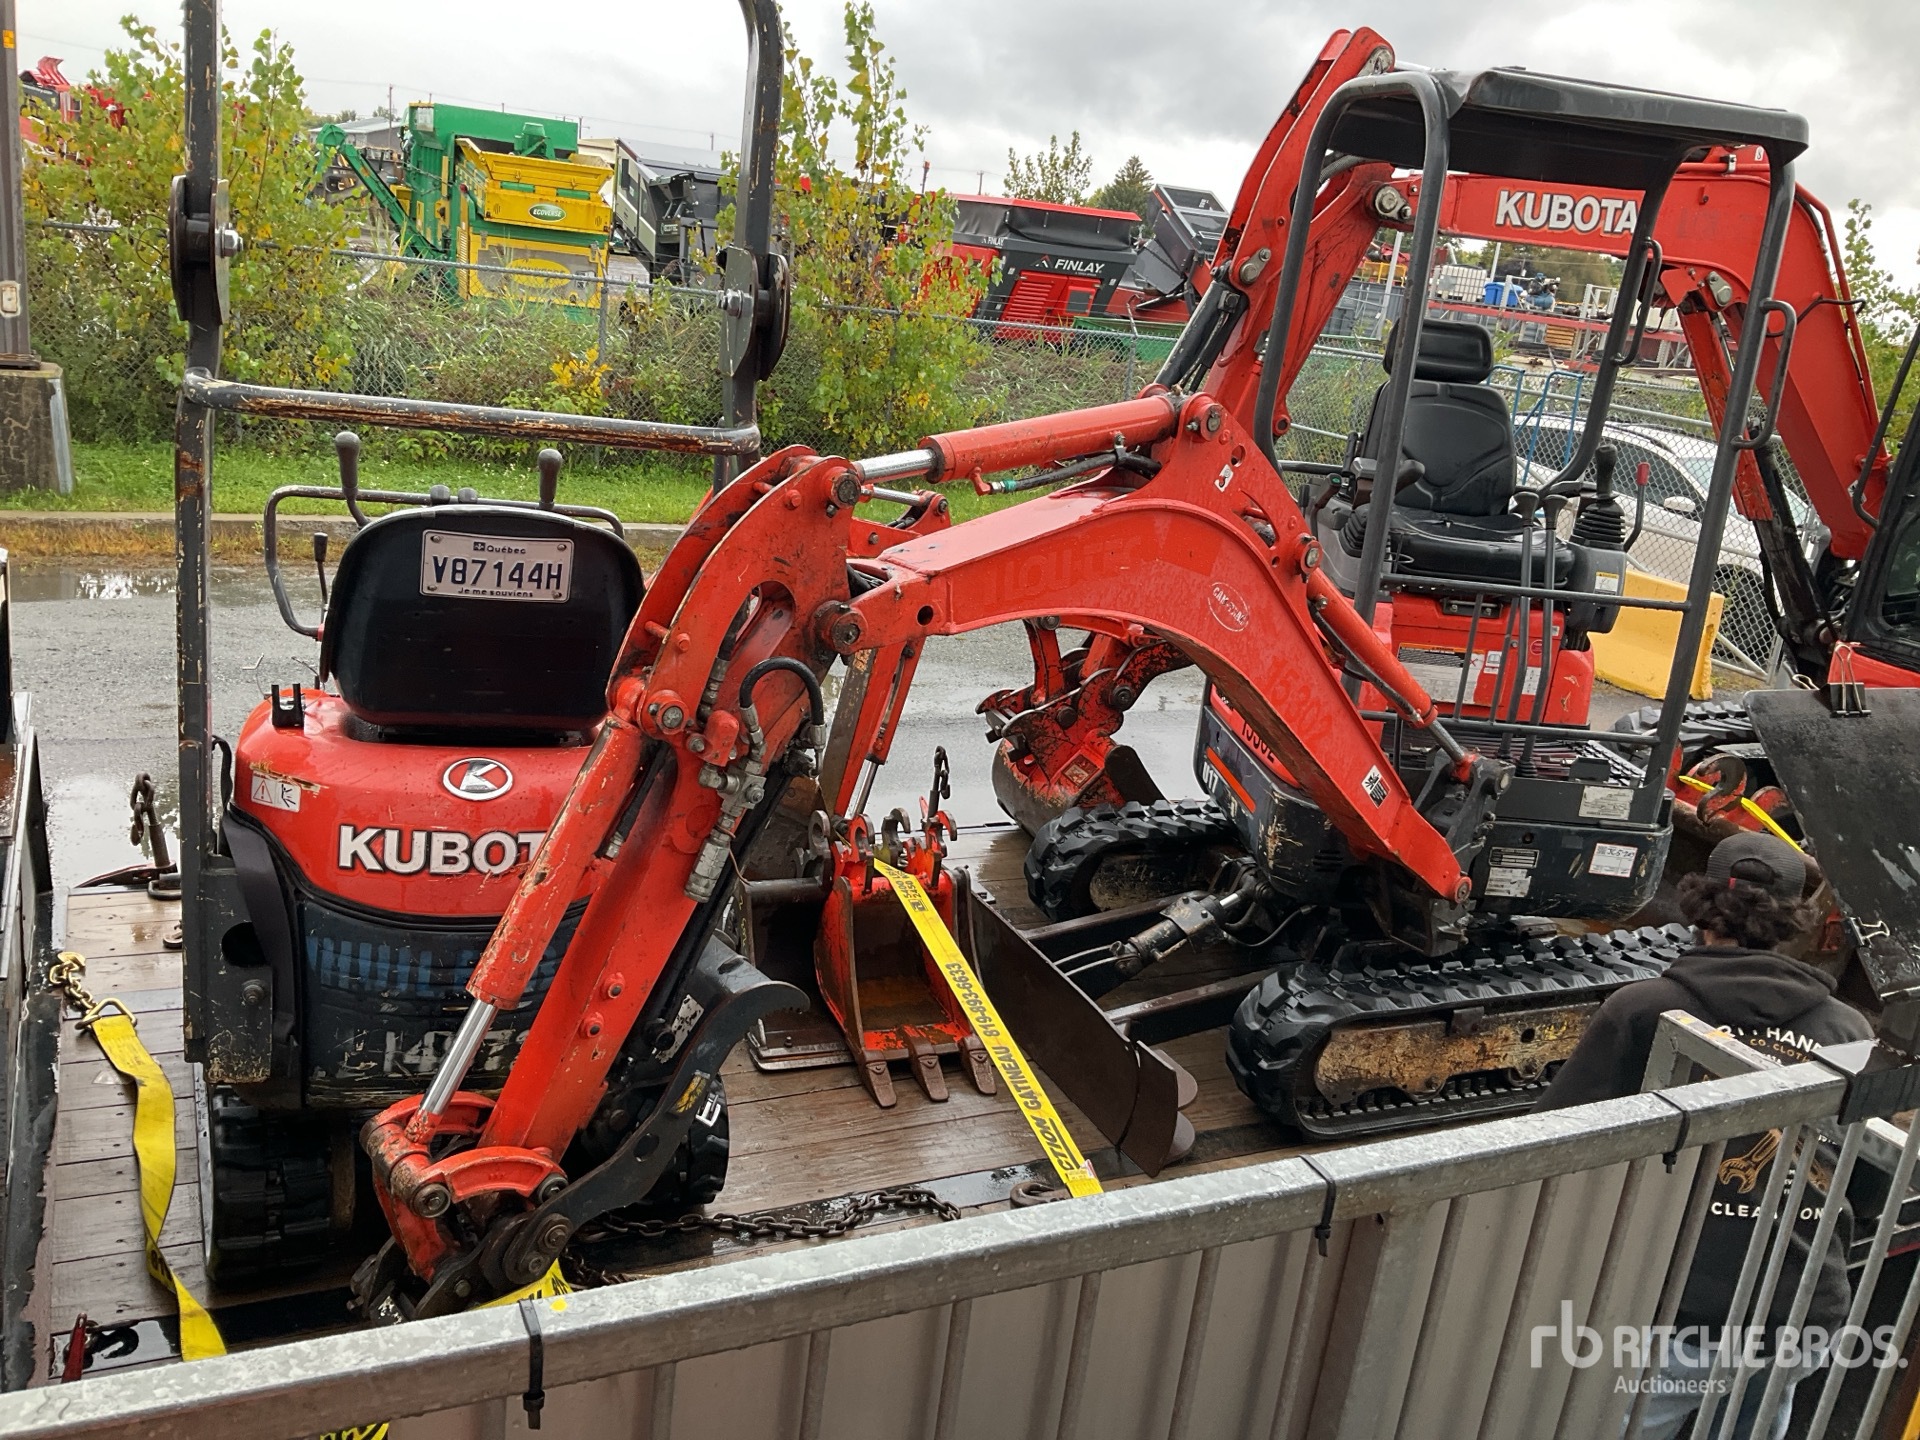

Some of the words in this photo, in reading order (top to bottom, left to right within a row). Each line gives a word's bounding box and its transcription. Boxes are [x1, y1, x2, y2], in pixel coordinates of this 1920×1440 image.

[532, 208, 563, 218] ECOVERSE
[1495, 189, 1638, 235] KUBOTA
[1054, 258, 1105, 273] FINLAY
[486, 544, 526, 555] Québec
[432, 555, 563, 590] V87144H
[489, 590, 534, 598] souviens
[338, 825, 550, 875] KUBOT
[945, 962, 1001, 1038] 819-893-6633
[1772, 1043, 1811, 1063] CLOTH
[991, 1045, 1042, 1111] GATINEAU
[1030, 1115, 1075, 1171] CTION
[1711, 1202, 1778, 1220] CLEA
